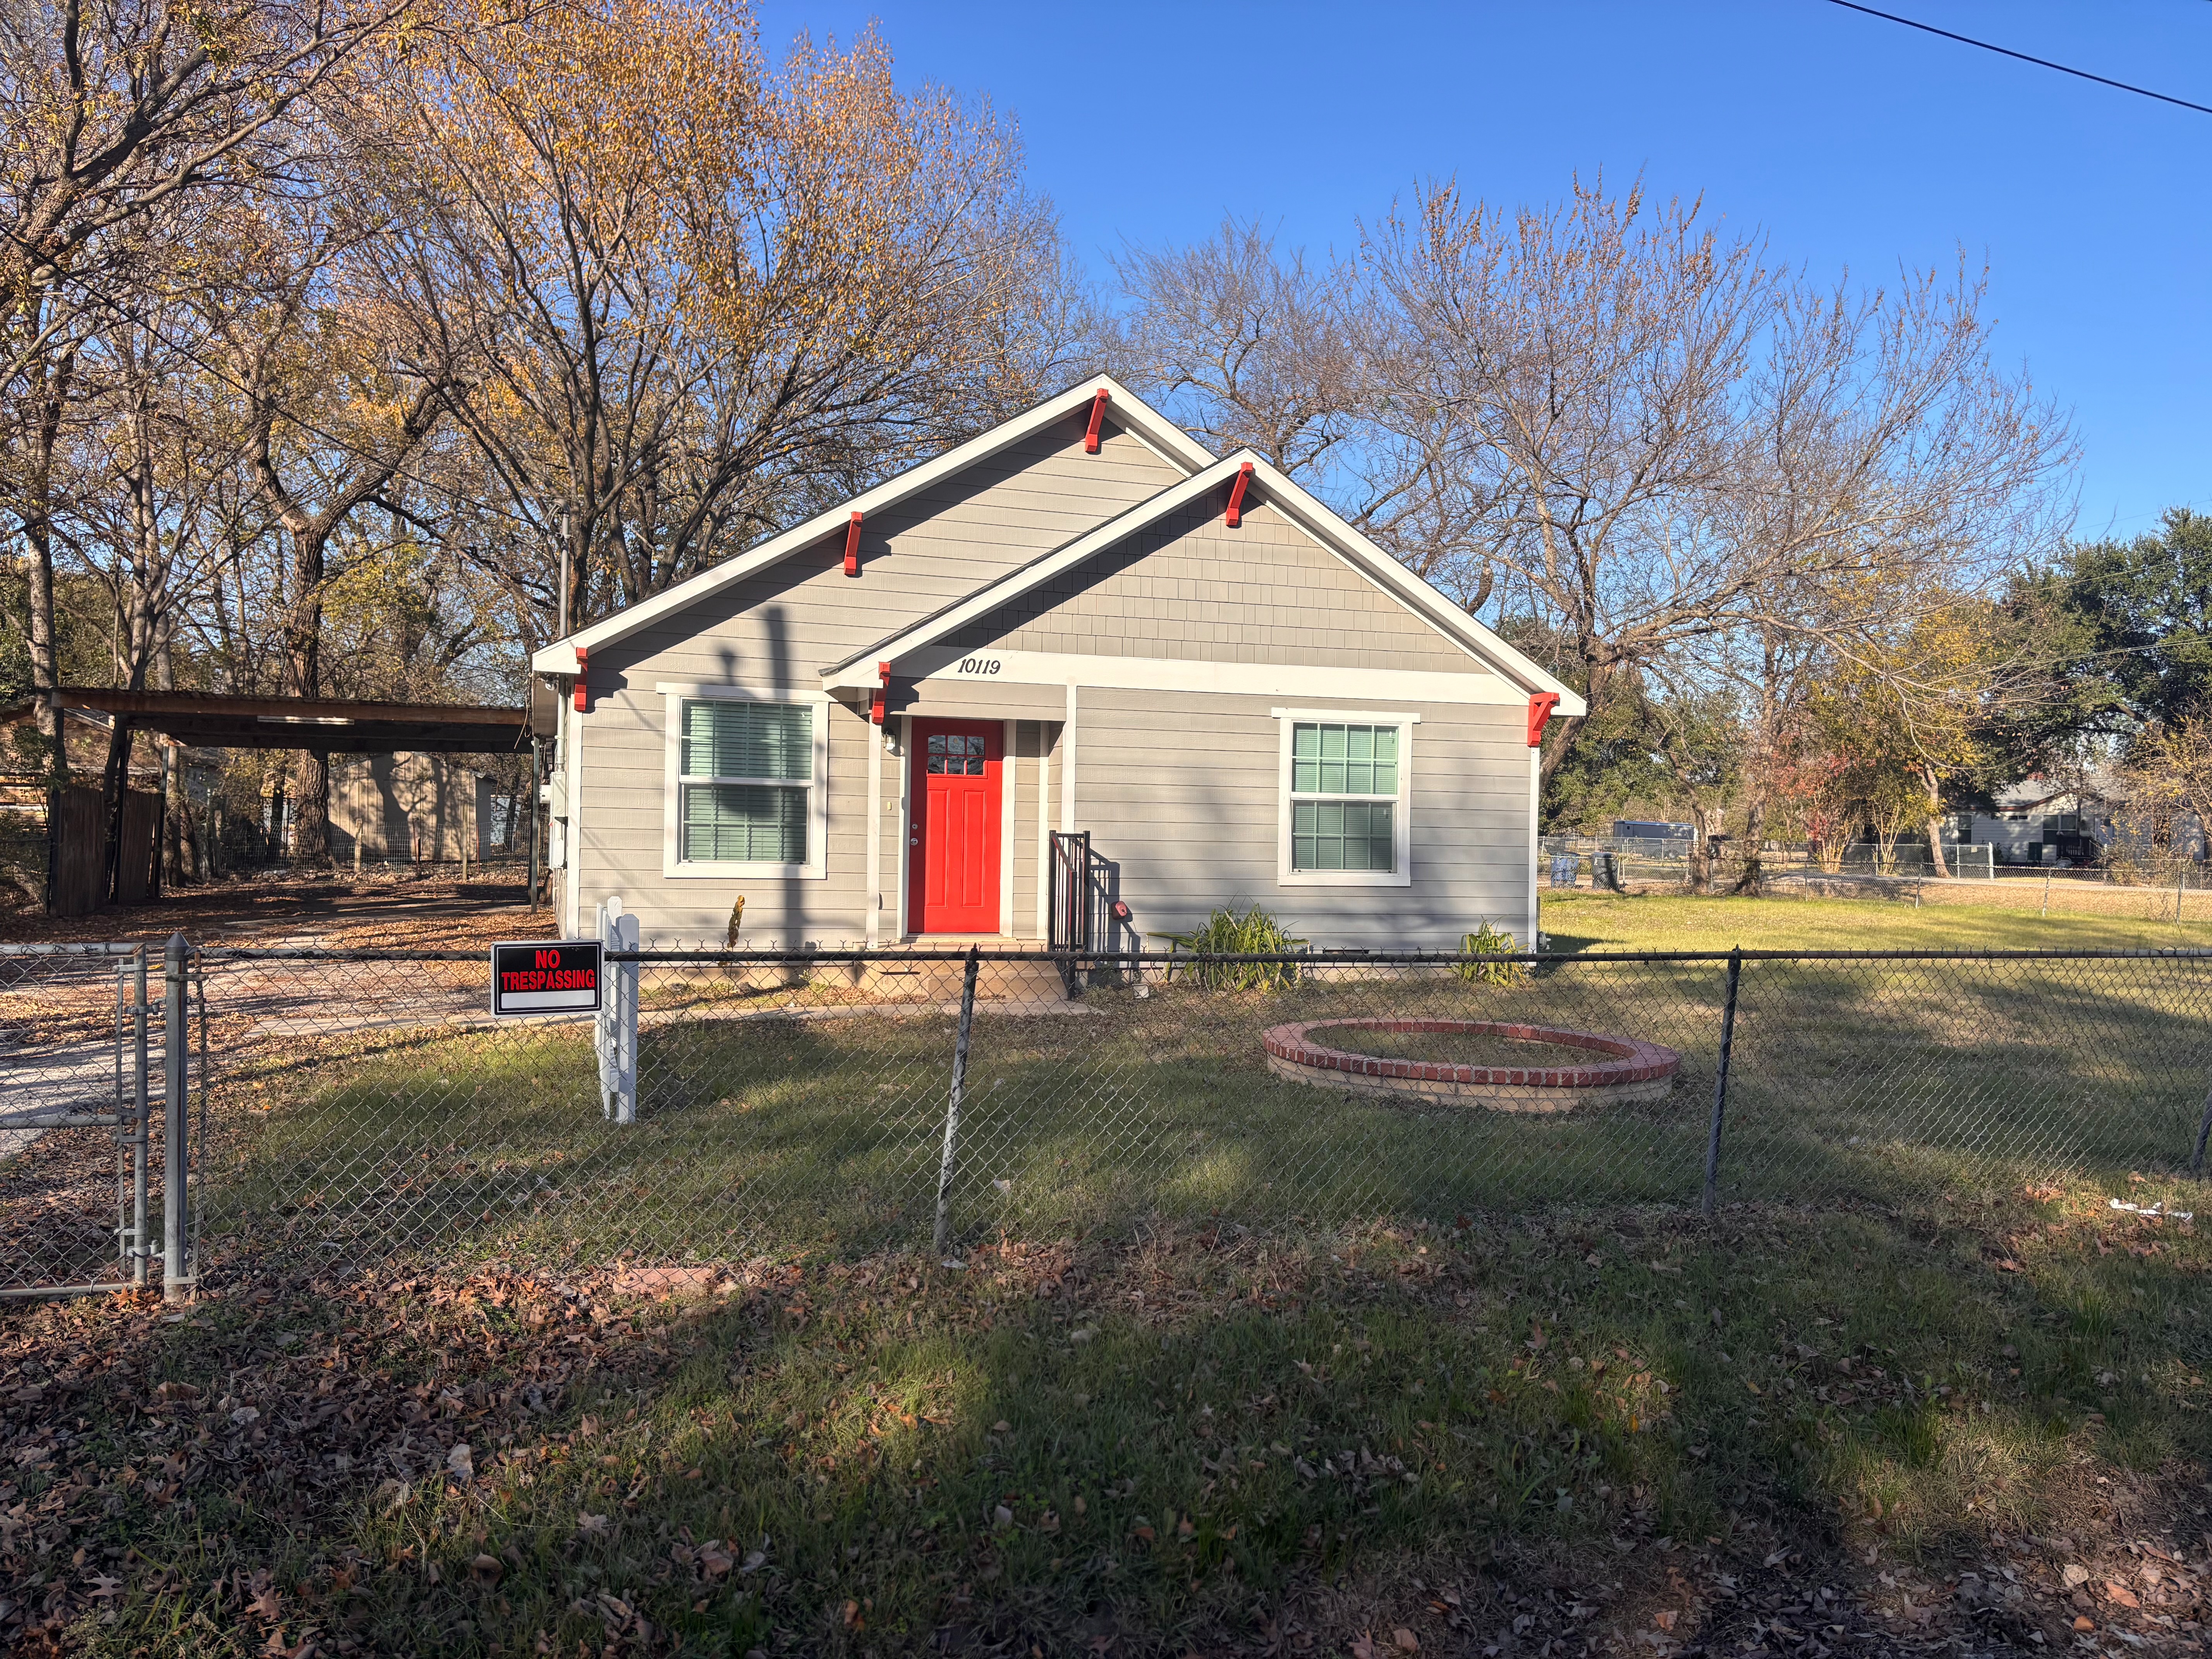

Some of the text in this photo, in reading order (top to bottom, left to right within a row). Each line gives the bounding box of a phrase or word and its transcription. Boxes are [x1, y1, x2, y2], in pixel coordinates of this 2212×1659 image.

[958, 658, 1001, 674] 10119
[535, 950, 560, 969] NO
[501, 969, 595, 990] TRESPASSING
